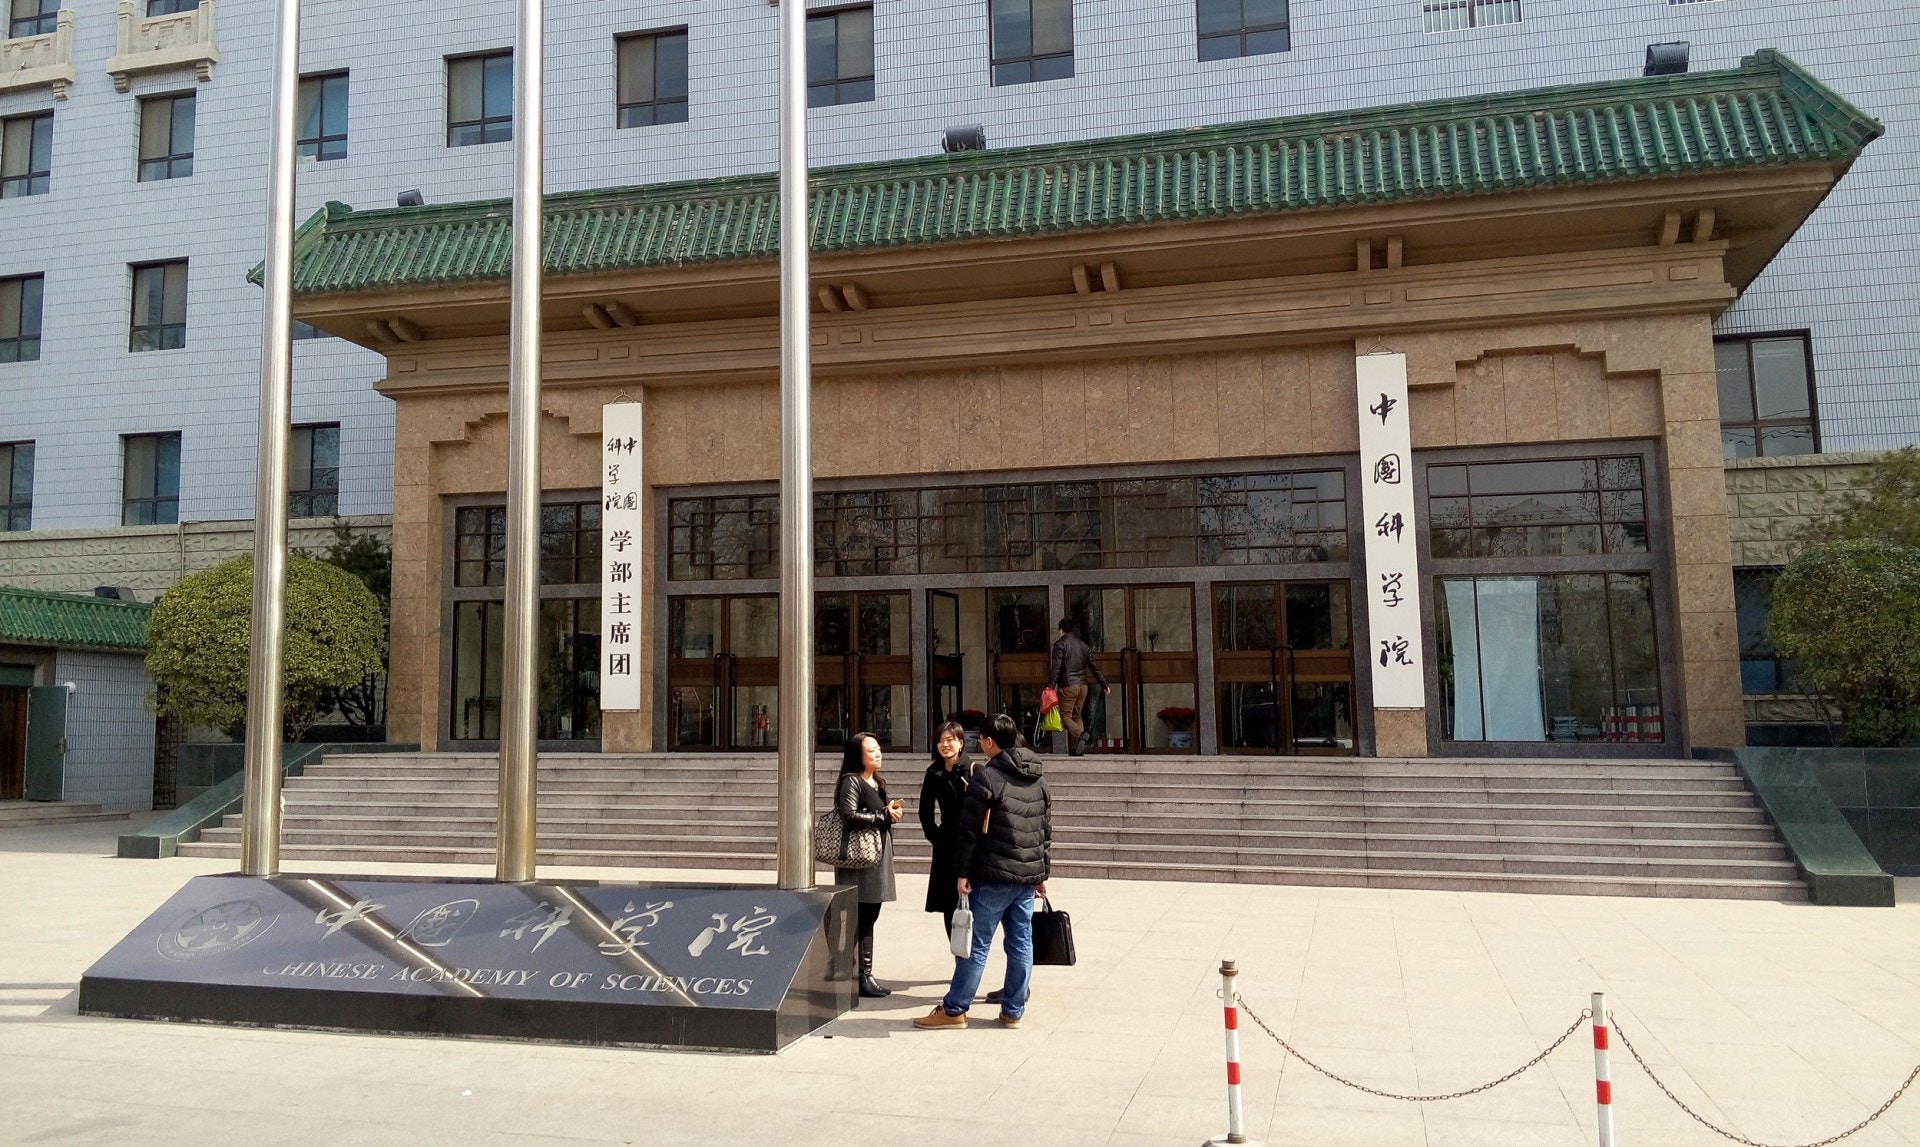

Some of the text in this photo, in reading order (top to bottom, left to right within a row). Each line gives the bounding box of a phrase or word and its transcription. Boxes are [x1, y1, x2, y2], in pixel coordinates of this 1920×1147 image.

[609, 530, 633, 676] 学部主席团
[262, 961, 754, 996] CHINESE ACADEMY OF SCIENCES
